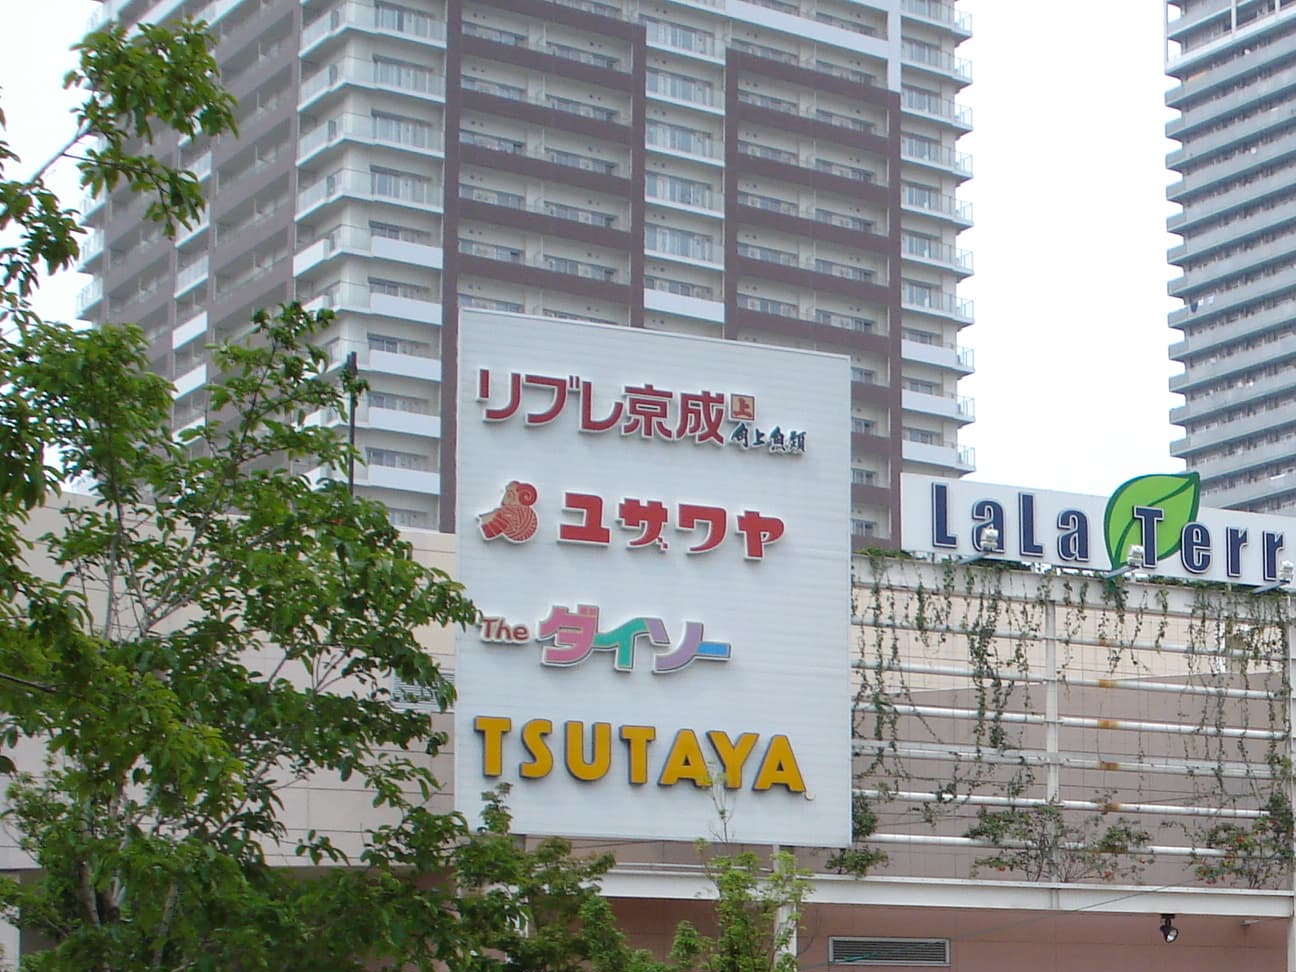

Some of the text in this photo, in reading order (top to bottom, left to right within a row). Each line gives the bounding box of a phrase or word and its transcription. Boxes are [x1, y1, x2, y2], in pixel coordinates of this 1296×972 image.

[478, 369, 726, 446] リブレ京成
[931, 482, 1090, 561] LaLa
[481, 605, 731, 671] The ダイソー
[475, 716, 806, 793] TSUTAYA
